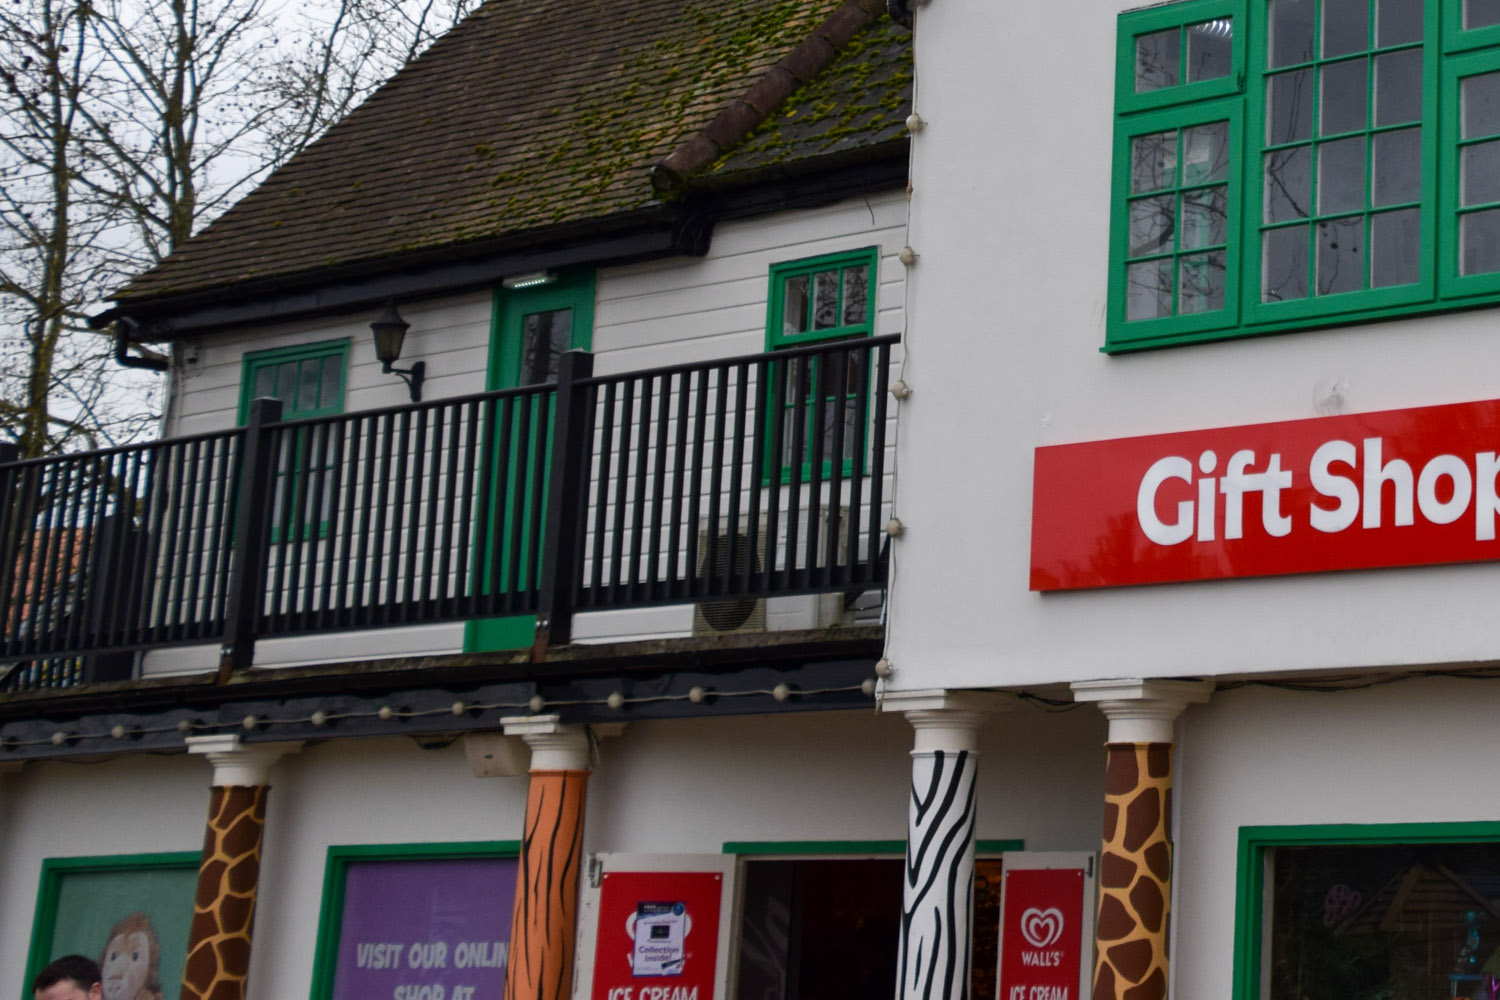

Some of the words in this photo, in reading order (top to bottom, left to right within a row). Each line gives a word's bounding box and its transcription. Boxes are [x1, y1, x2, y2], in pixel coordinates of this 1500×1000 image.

[1137, 449, 1292, 546] Gift
[357, 943, 404, 969] VISIT
[408, 942, 448, 969] OUR
[454, 942, 509, 968] ONLIN
[638, 946, 680, 954] Collection
[1022, 951, 1060, 967] WALL'S
